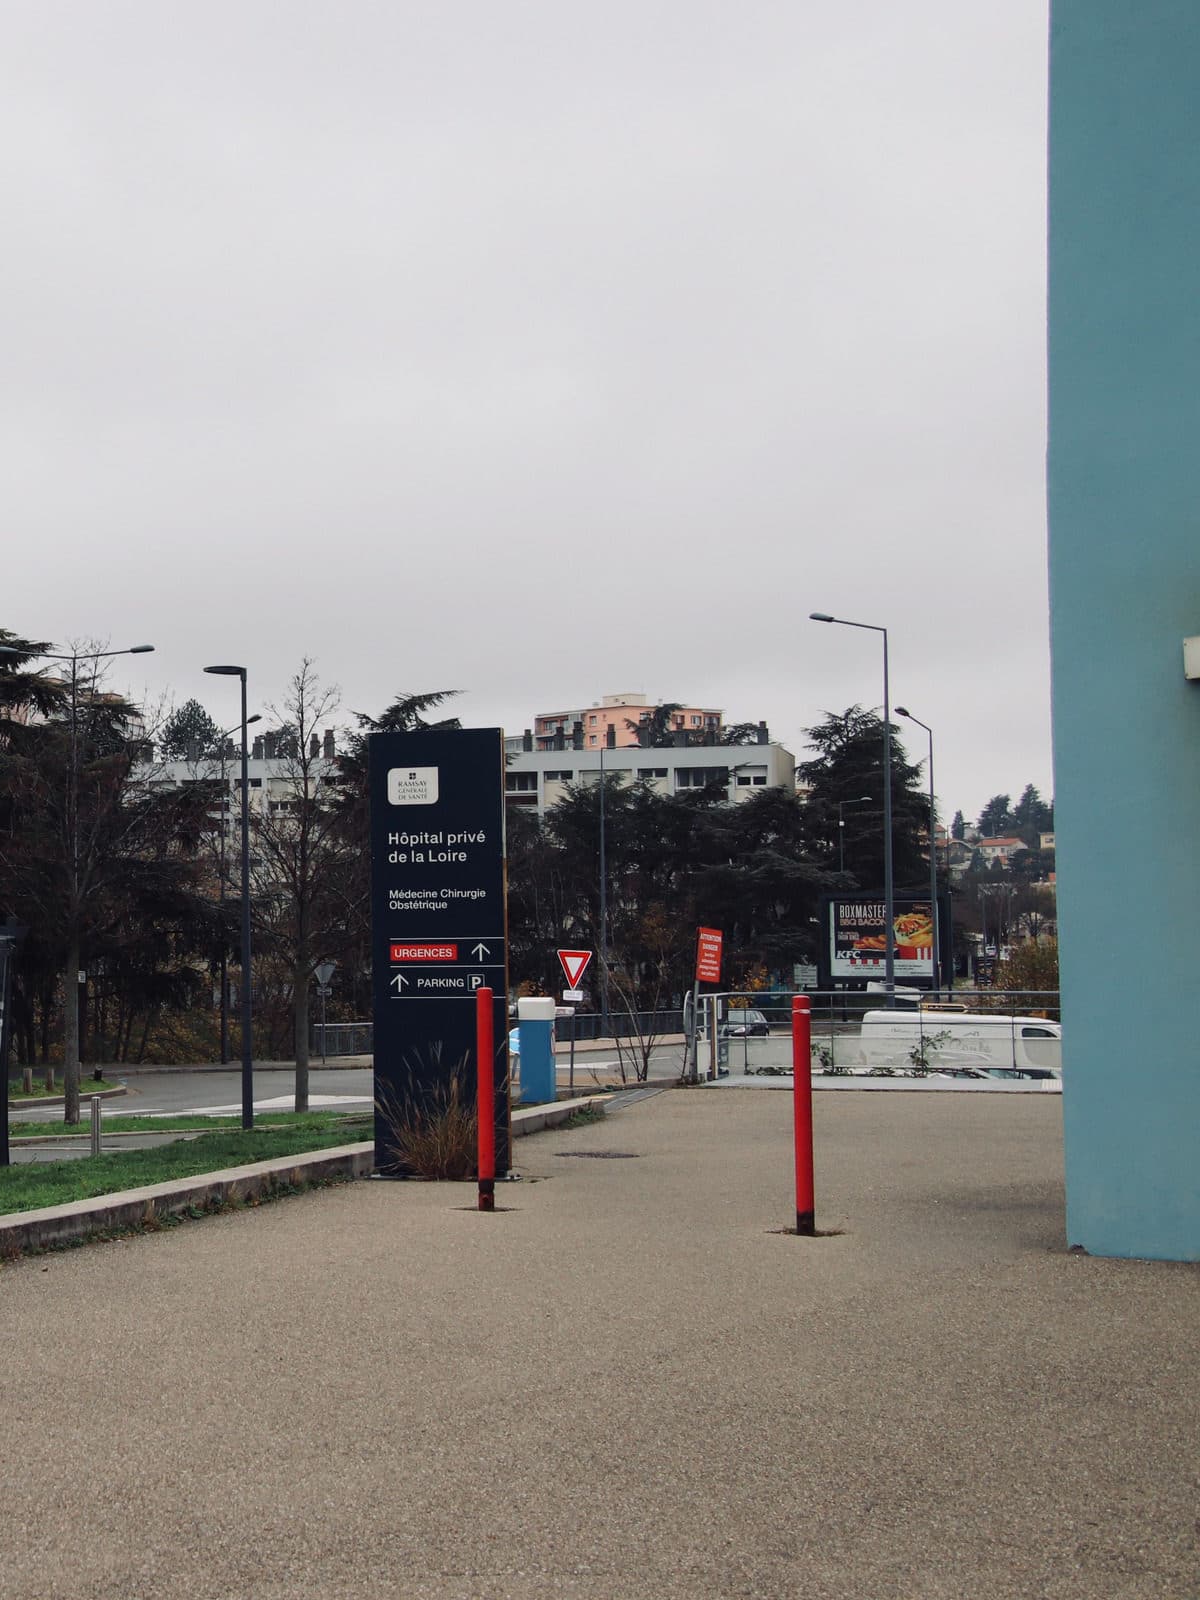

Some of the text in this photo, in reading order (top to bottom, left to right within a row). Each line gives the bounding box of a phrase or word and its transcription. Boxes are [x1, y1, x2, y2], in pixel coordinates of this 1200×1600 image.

[388, 830, 486, 847] Hôpital privé
[388, 849, 468, 863] de la Loire
[389, 888, 487, 900] Médecine Chirurgie
[389, 900, 448, 911] Obstétrique
[394, 948, 453, 958] URGENCES
[836, 950, 861, 959] KFC
[417, 978, 464, 988] PARKING
